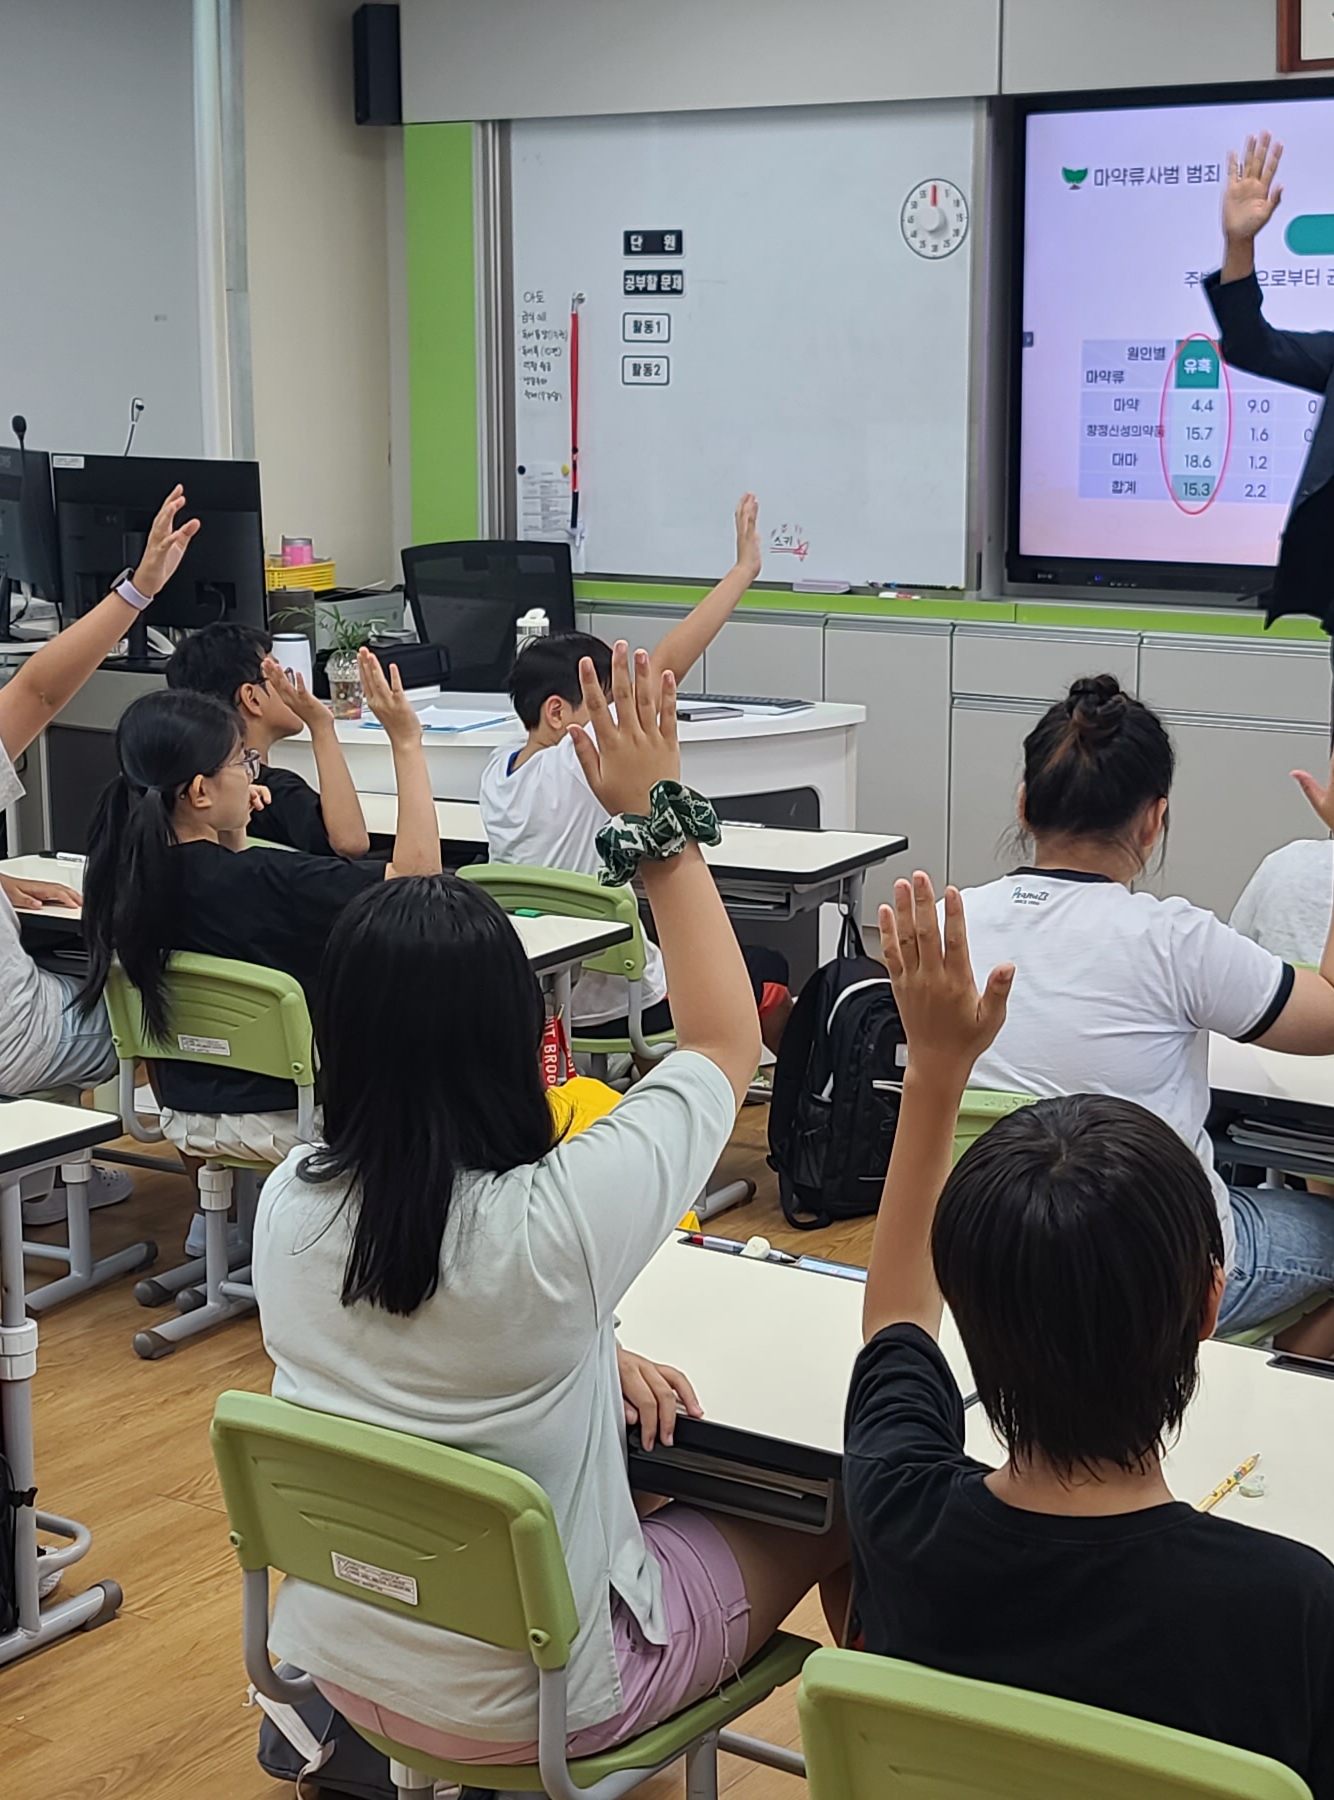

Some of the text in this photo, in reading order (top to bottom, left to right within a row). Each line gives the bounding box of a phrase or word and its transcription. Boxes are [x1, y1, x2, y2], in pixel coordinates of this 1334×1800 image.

[1094, 164, 1180, 187] 마약류사범
[1187, 163, 1220, 184] 범죄
[625, 274, 682, 291] 공부할 문제
[1184, 270, 1209, 289] 주
[1256, 267, 1320, 287] 으로부터
[633, 319, 661, 334] 활동1
[1127, 346, 1166, 361] 원인별
[632, 362, 661, 377] 활동2
[1183, 358, 1212, 374] 유혹
[1085, 369, 1125, 384] 마약류
[1113, 398, 1139, 412] 마약
[1191, 399, 1214, 413] 4.4
[1247, 399, 1270, 413] 9.0
[1186, 427, 1213, 440] 15.7
[1250, 428, 1269, 442] 1.6
[1112, 452, 1267, 470] 대마 18.6 1.2
[1111, 480, 1266, 498] 합계 15.3 2.2
[543, 1043, 558, 1089] BROO
